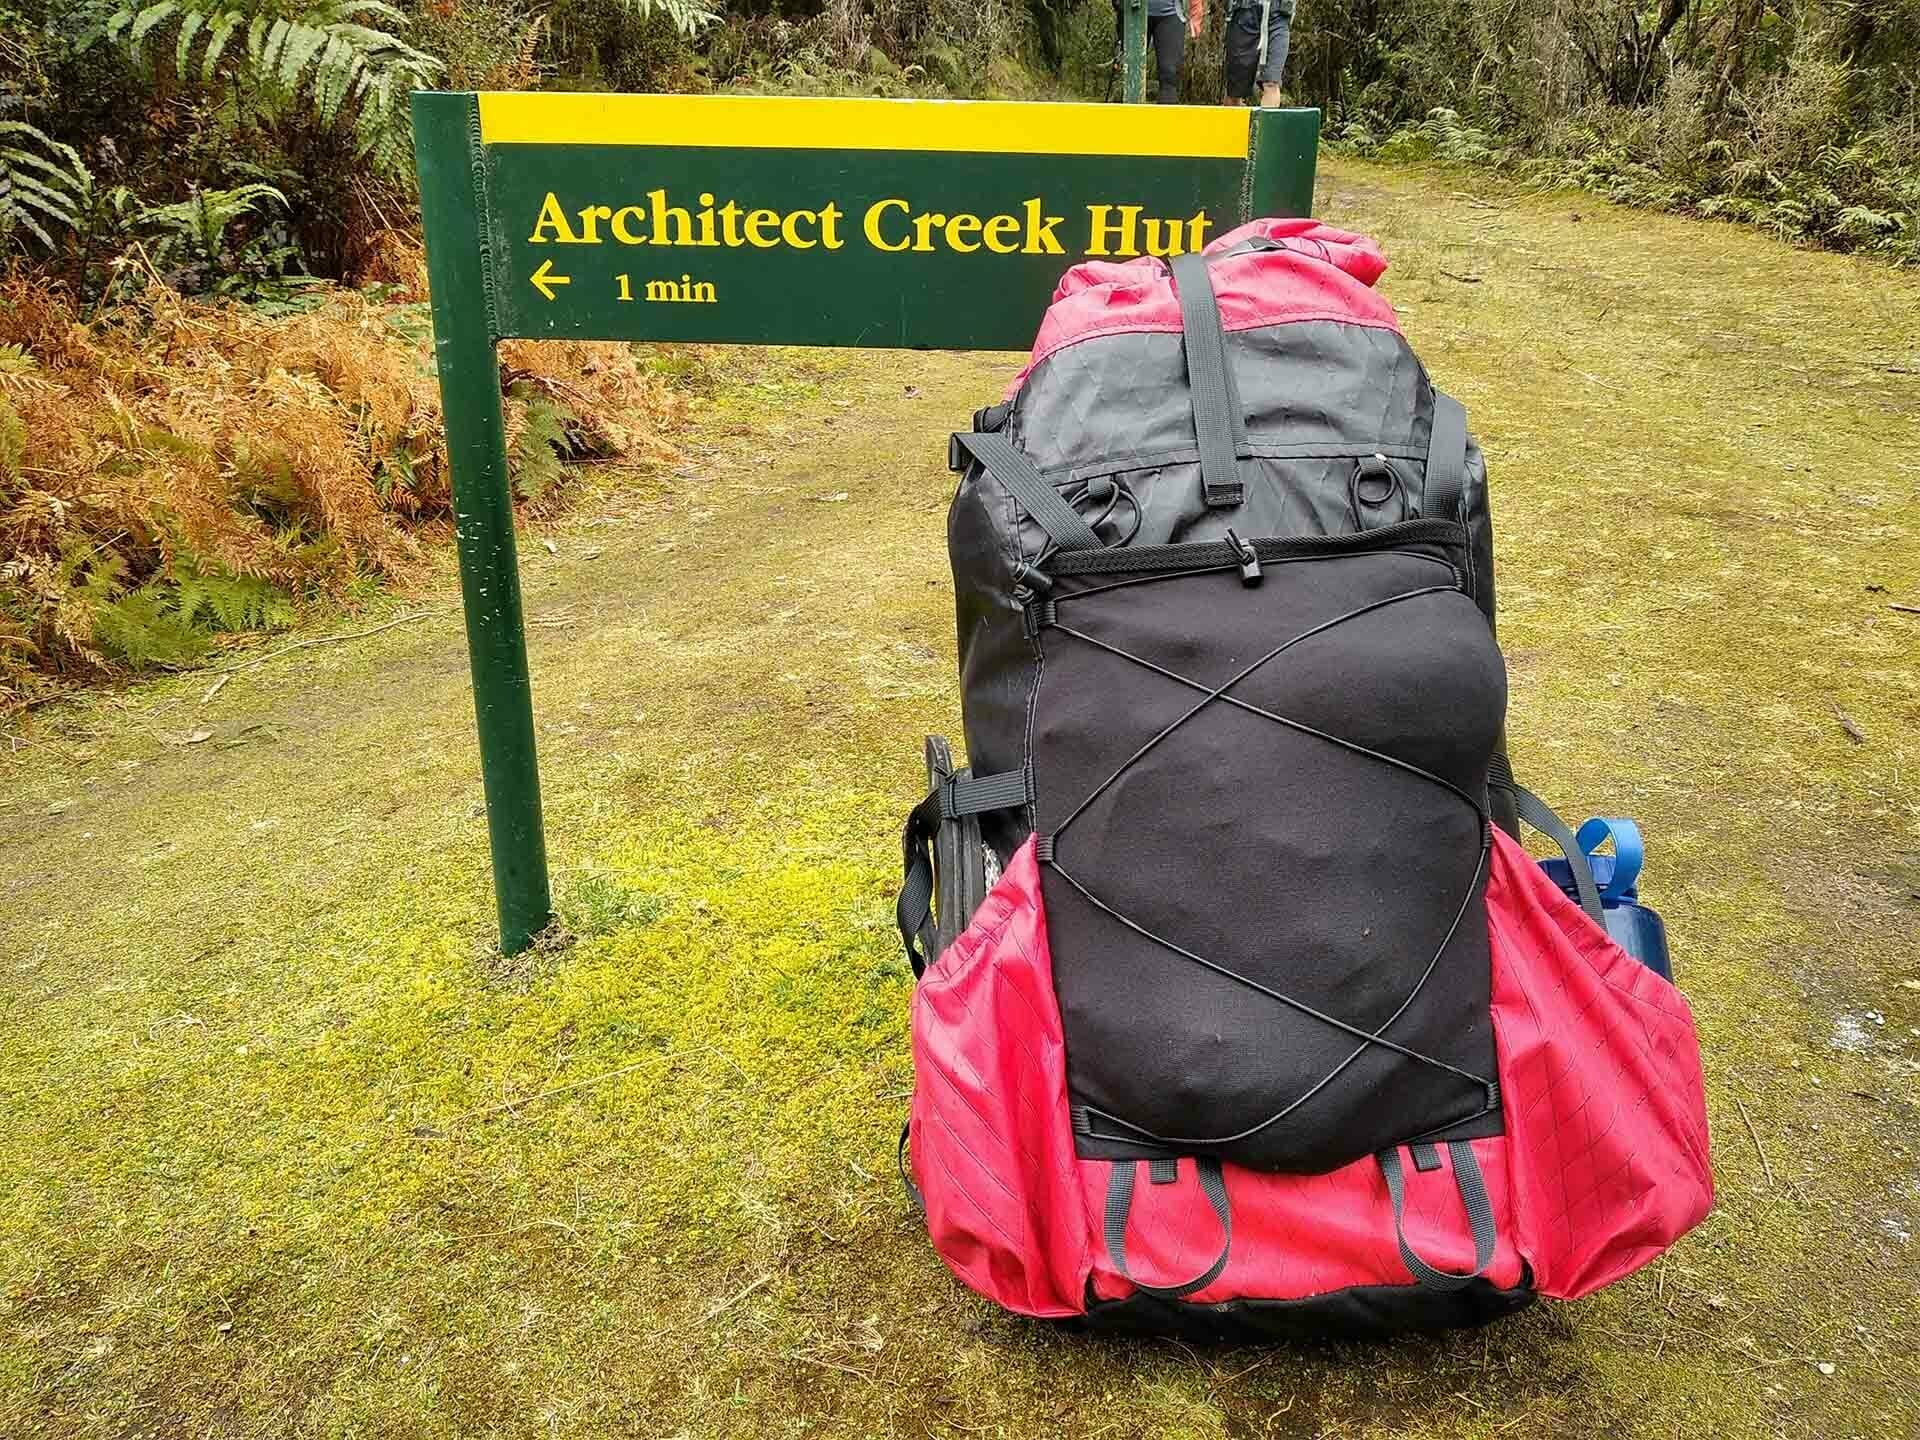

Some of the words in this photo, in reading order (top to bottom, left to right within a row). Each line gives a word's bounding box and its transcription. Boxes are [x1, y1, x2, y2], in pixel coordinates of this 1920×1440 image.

[528, 189, 845, 250] Architect
[863, 198, 1066, 256] Creek
[1084, 204, 1213, 258] Hut
[615, 273, 634, 301] 1
[645, 274, 718, 304] min
